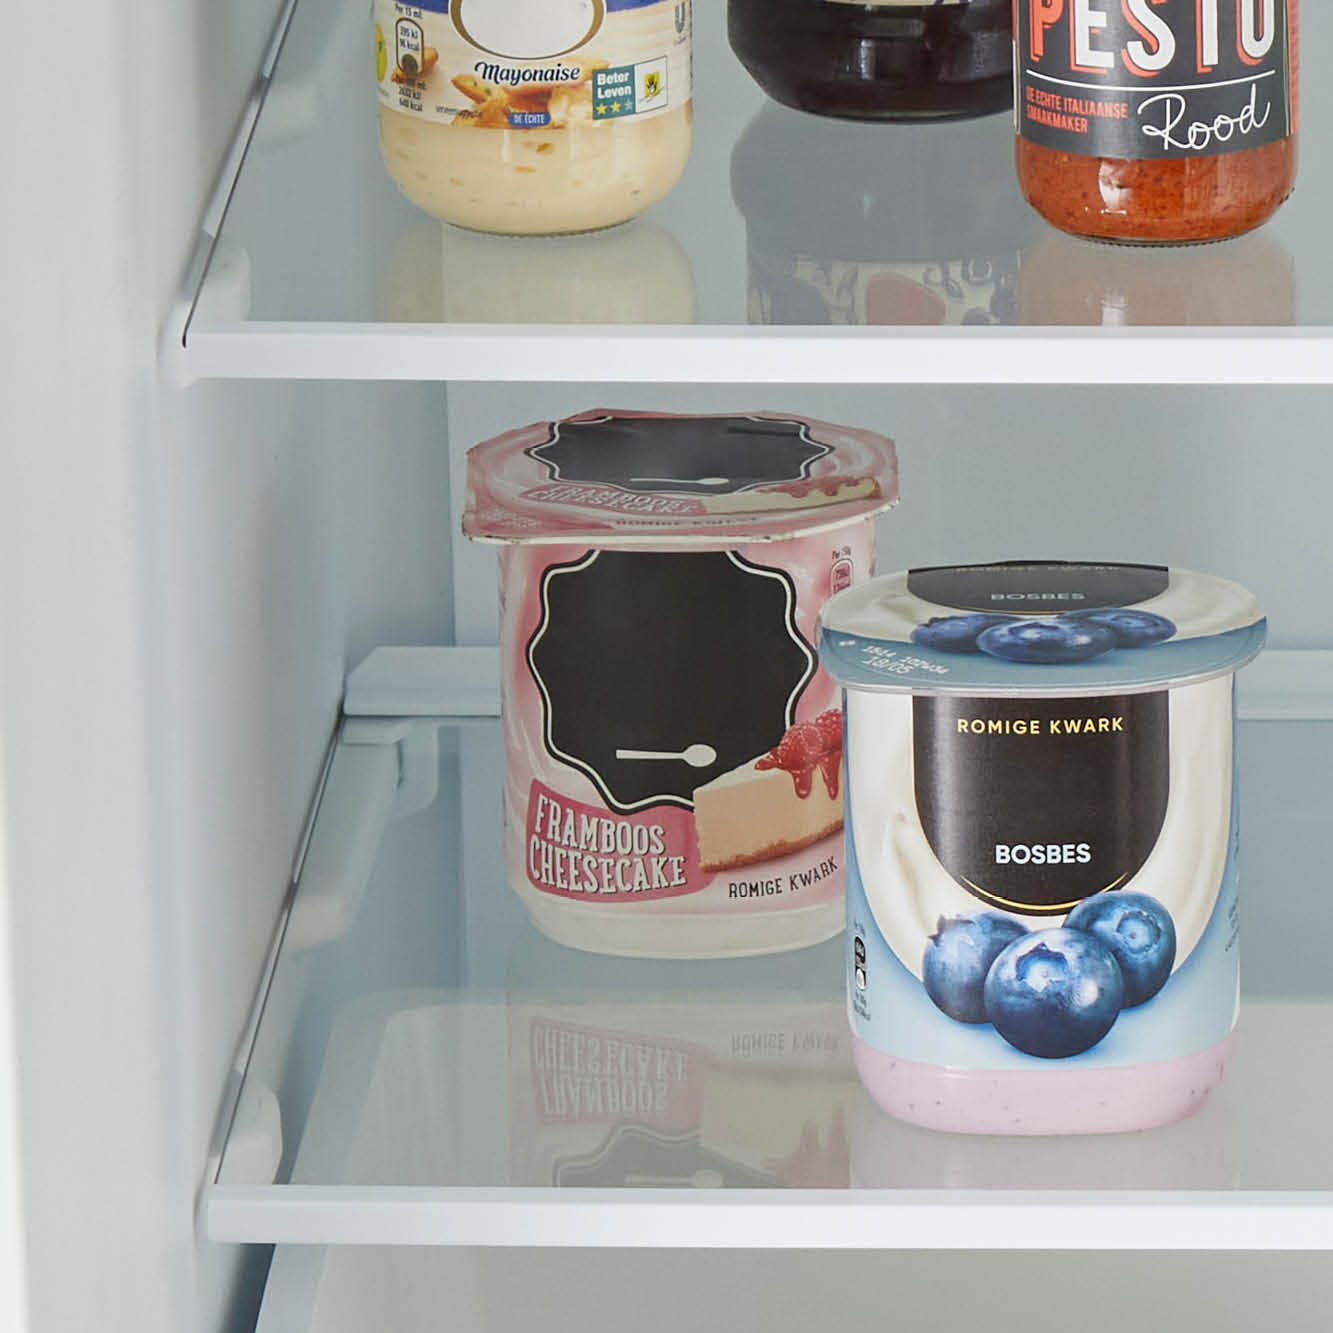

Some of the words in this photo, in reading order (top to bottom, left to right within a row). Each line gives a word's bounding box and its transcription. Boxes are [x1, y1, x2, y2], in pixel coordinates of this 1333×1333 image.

[474, 61, 581, 86] Mayonaise
[597, 71, 630, 86] Beter
[598, 85, 632, 99] Leven
[1063, 95, 1129, 119] ITALIAANSE
[1137, 83, 1271, 150] Rood
[957, 718, 1040, 735] ROMIGE
[1050, 717, 1124, 734] KWARK
[534, 793, 666, 855] FRAMBOOS
[529, 836, 687, 894] CHEESECAKE
[995, 843, 1092, 865] BOSBES
[728, 875, 784, 899] ROMIGE
[789, 856, 838, 890] KWARK
